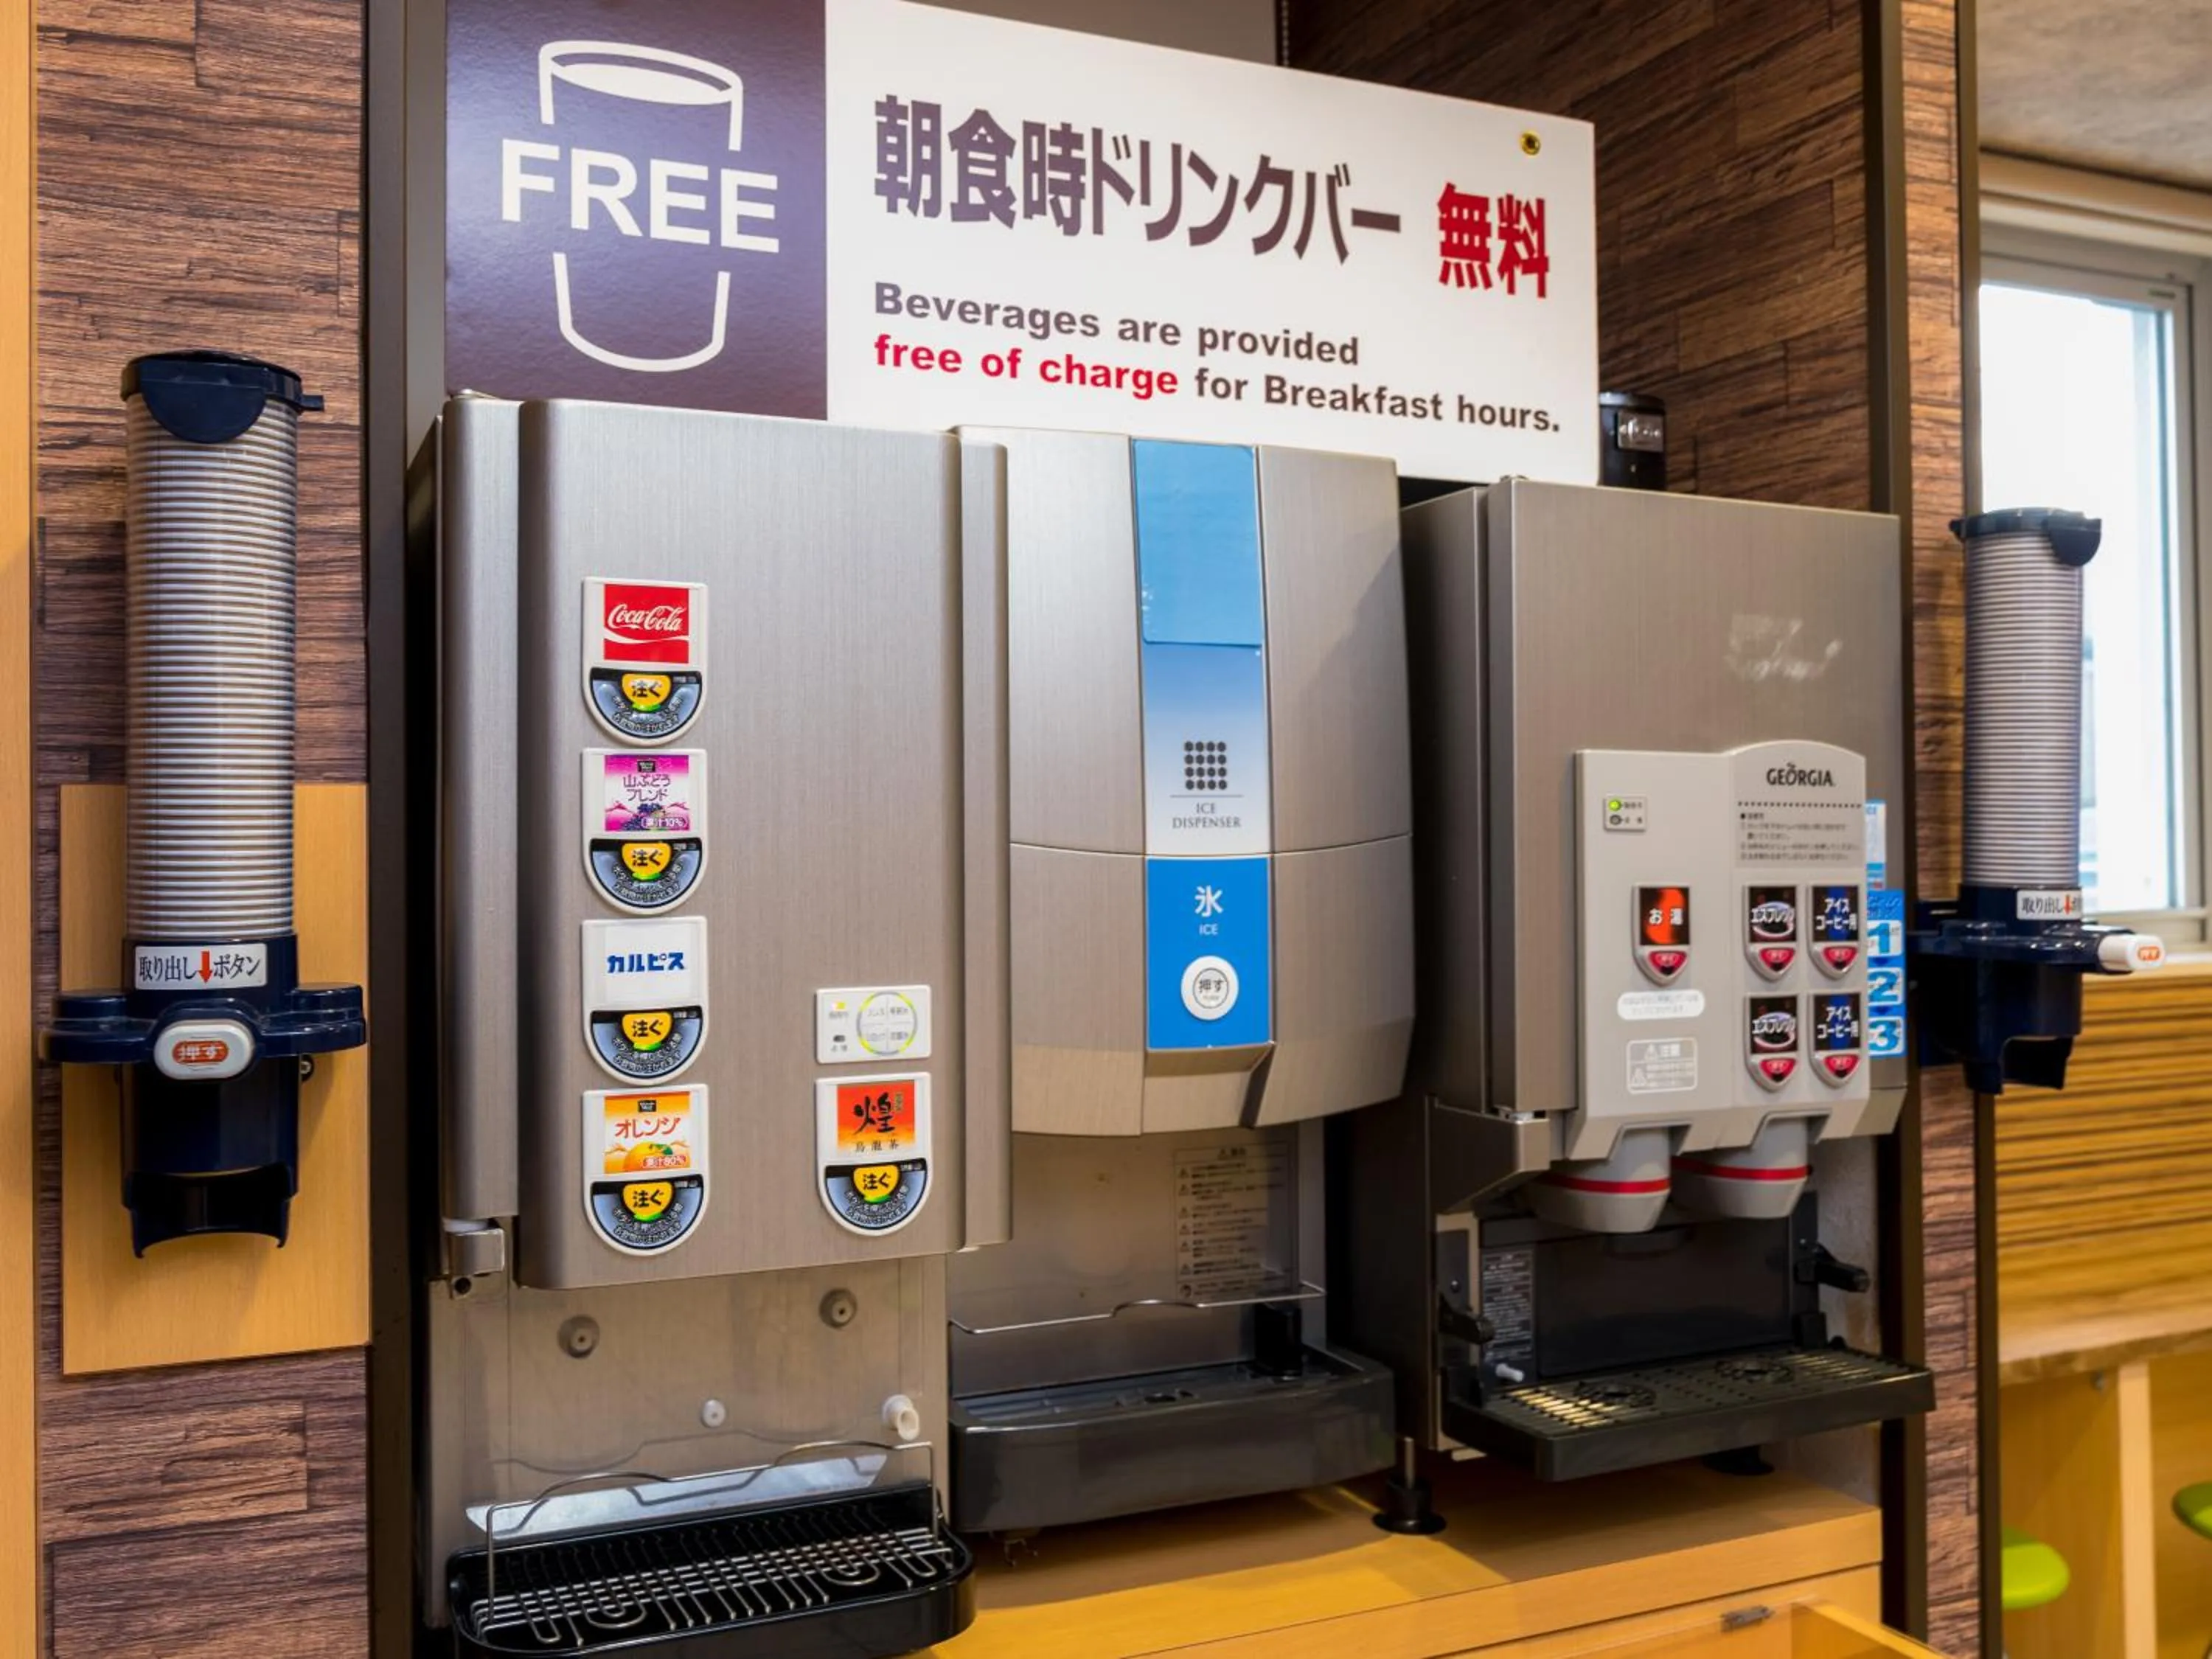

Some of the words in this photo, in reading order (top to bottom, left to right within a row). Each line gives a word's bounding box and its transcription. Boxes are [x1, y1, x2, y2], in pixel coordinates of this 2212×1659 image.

[501, 138, 779, 253] FREE
[874, 94, 1402, 265] 朝食時ドリンクバー
[1436, 181, 1551, 299] 無料
[875, 282, 1100, 341] Beverages
[1117, 319, 1181, 346] are
[1198, 327, 1359, 366] provided
[874, 333, 963, 374] free
[980, 347, 1023, 379] of
[1039, 353, 1179, 401] charge
[1194, 366, 1248, 400] for
[1265, 374, 1443, 422] Breakfast
[1457, 394, 1562, 432] hours.
[607, 602, 687, 632] Coca-Cola
[1172, 815, 1242, 830] DISPENSER
[1196, 802, 1216, 815] ICE
[631, 849, 664, 867] 注ぐ
[1194, 885, 1224, 917] 氷
[1198, 924, 1219, 936] ICE
[1867, 922, 1891, 954] 1
[139, 955, 198, 982] 取り出し
[213, 953, 261, 980] ボタン
[606, 951, 686, 974] カルピス
[1868, 970, 1899, 1004] 2
[632, 1019, 664, 1037] 注ぐ
[1868, 1019, 1900, 1052] 3
[613, 1116, 681, 1139] オレンジ
[862, 1172, 891, 1190] 注ぐ
[633, 1189, 664, 1208] 注ぐ
